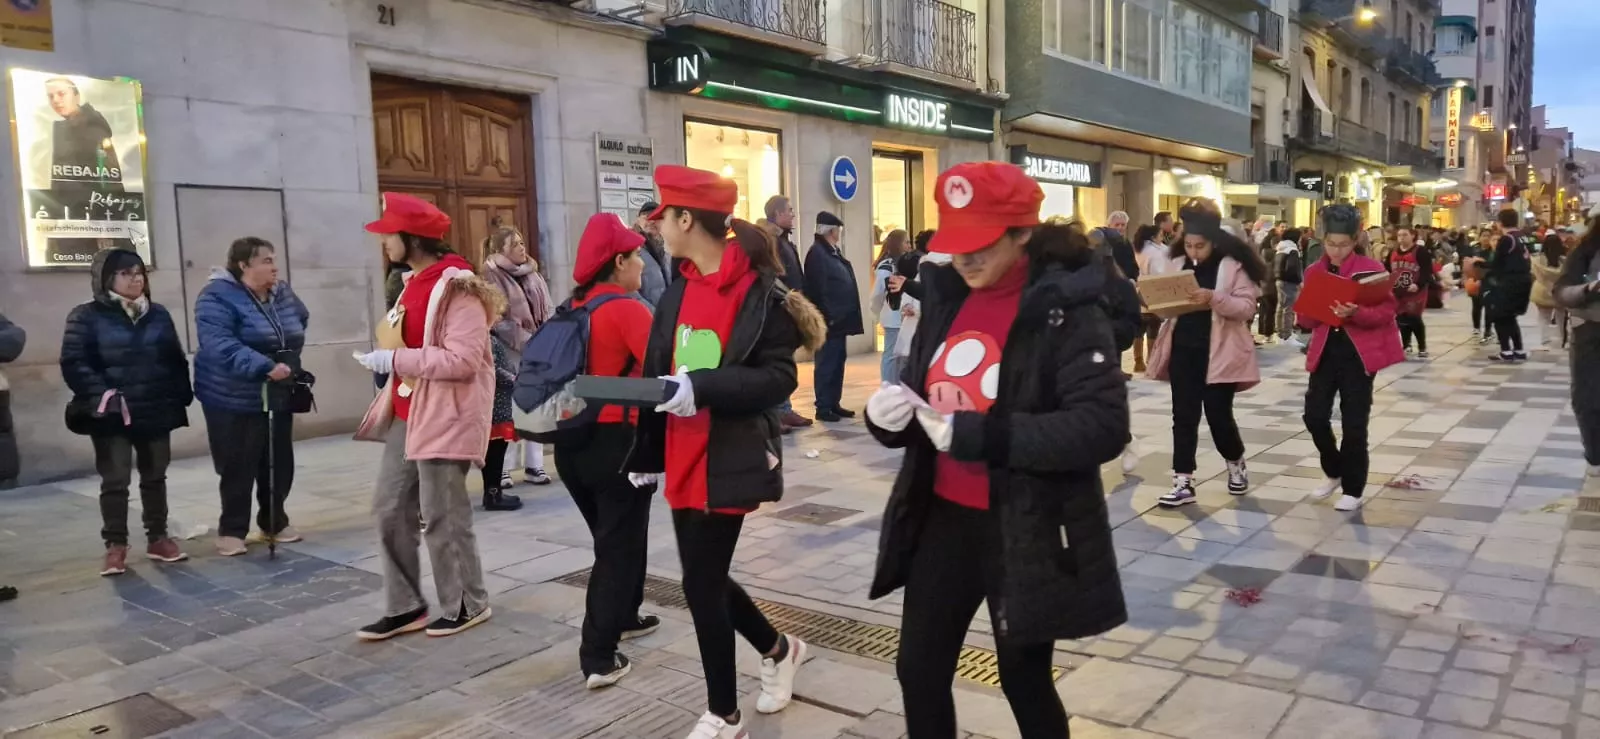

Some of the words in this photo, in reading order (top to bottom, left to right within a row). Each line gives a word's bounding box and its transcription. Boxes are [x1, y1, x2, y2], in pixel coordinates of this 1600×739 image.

[377, 4, 396, 26] 21
[677, 54, 698, 82] IN
[889, 94, 947, 131] INSIDE
[1448, 88, 1458, 167] FARMACIA
[53, 165, 120, 178] REBAJAS
[1024, 156, 1091, 183] CALZEDONIA
[948, 182, 967, 195] M
[88, 190, 142, 211] Rebajas
[53, 253, 73, 261] Coso
[75, 253, 93, 262] Bajo
